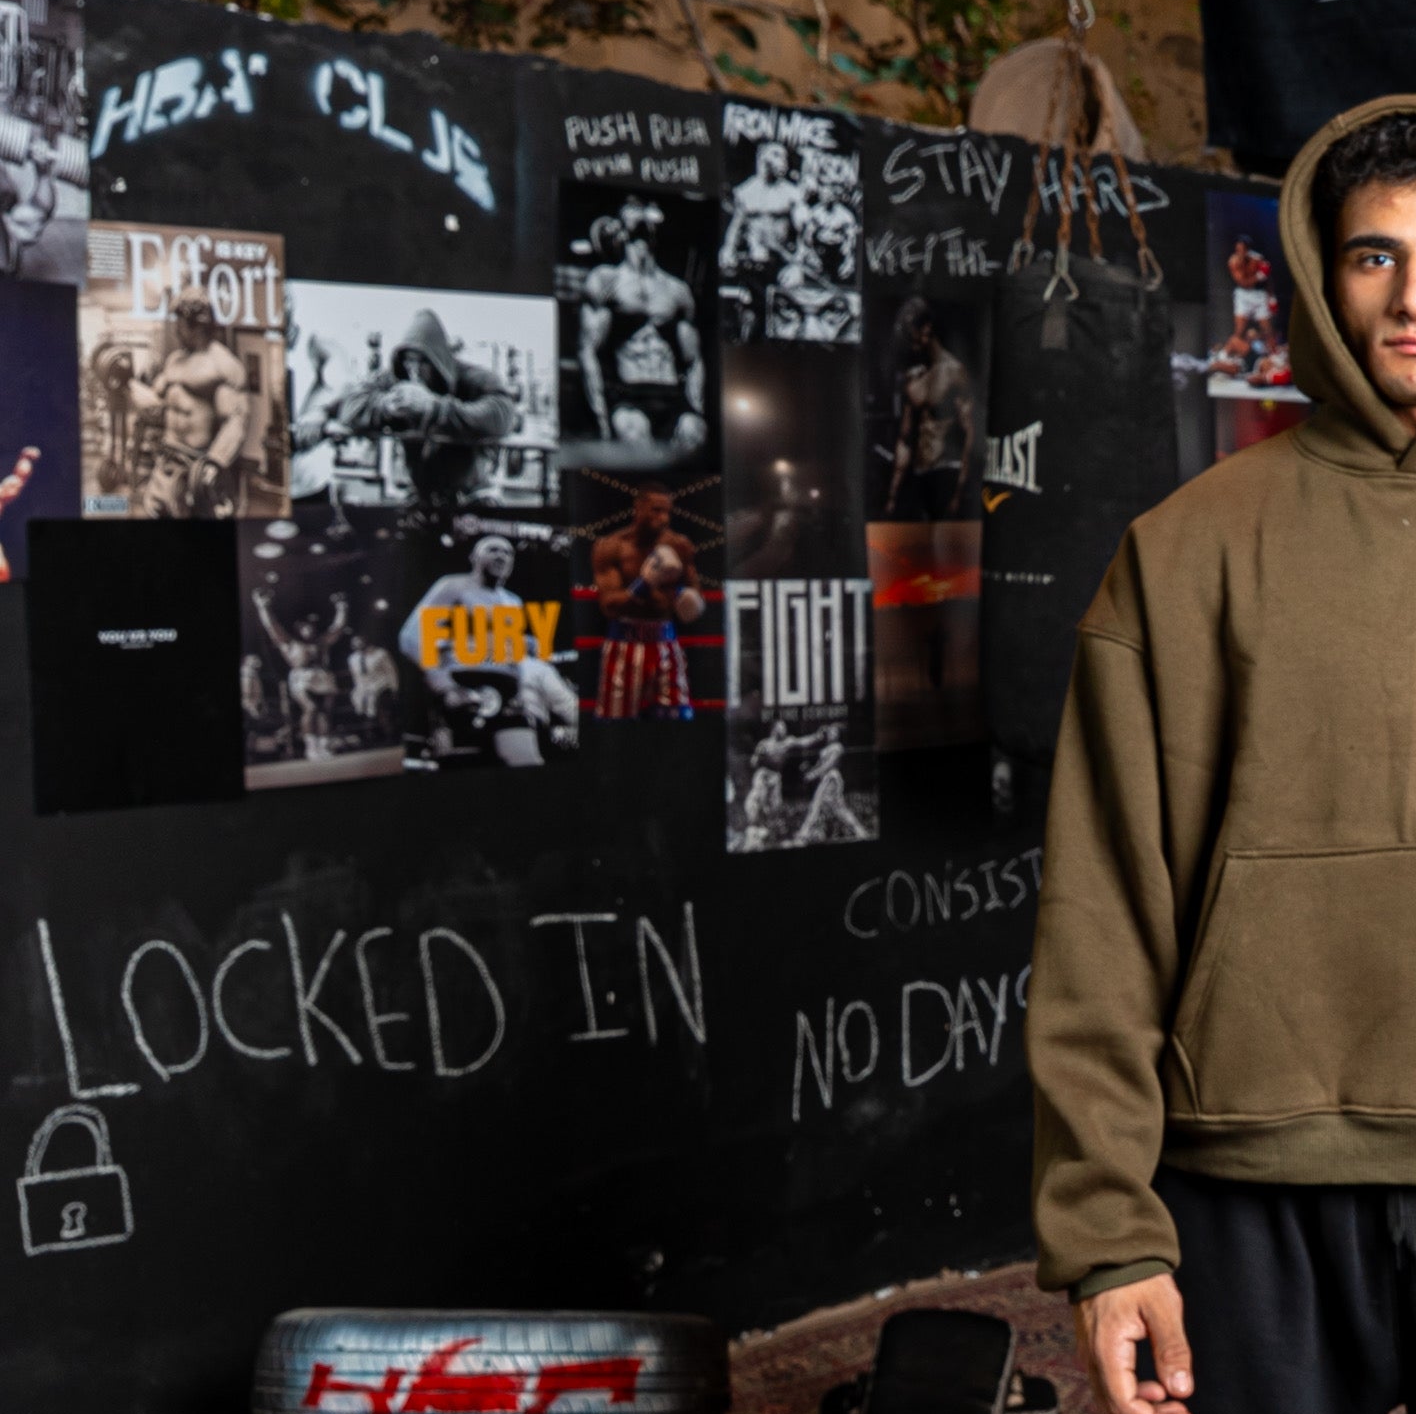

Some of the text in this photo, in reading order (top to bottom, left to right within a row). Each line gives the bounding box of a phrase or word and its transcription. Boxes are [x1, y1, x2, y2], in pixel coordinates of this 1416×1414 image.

[564, 110, 711, 151] PUSH PUSH
[640, 155, 700, 185] PUSH
[882, 138, 1170, 218] STAY HARD
[420, 601, 561, 669] FURY
[725, 578, 874, 708] FIGHT
[38, 901, 706, 1100] LOCKED IN
[792, 996, 879, 1122] NO
